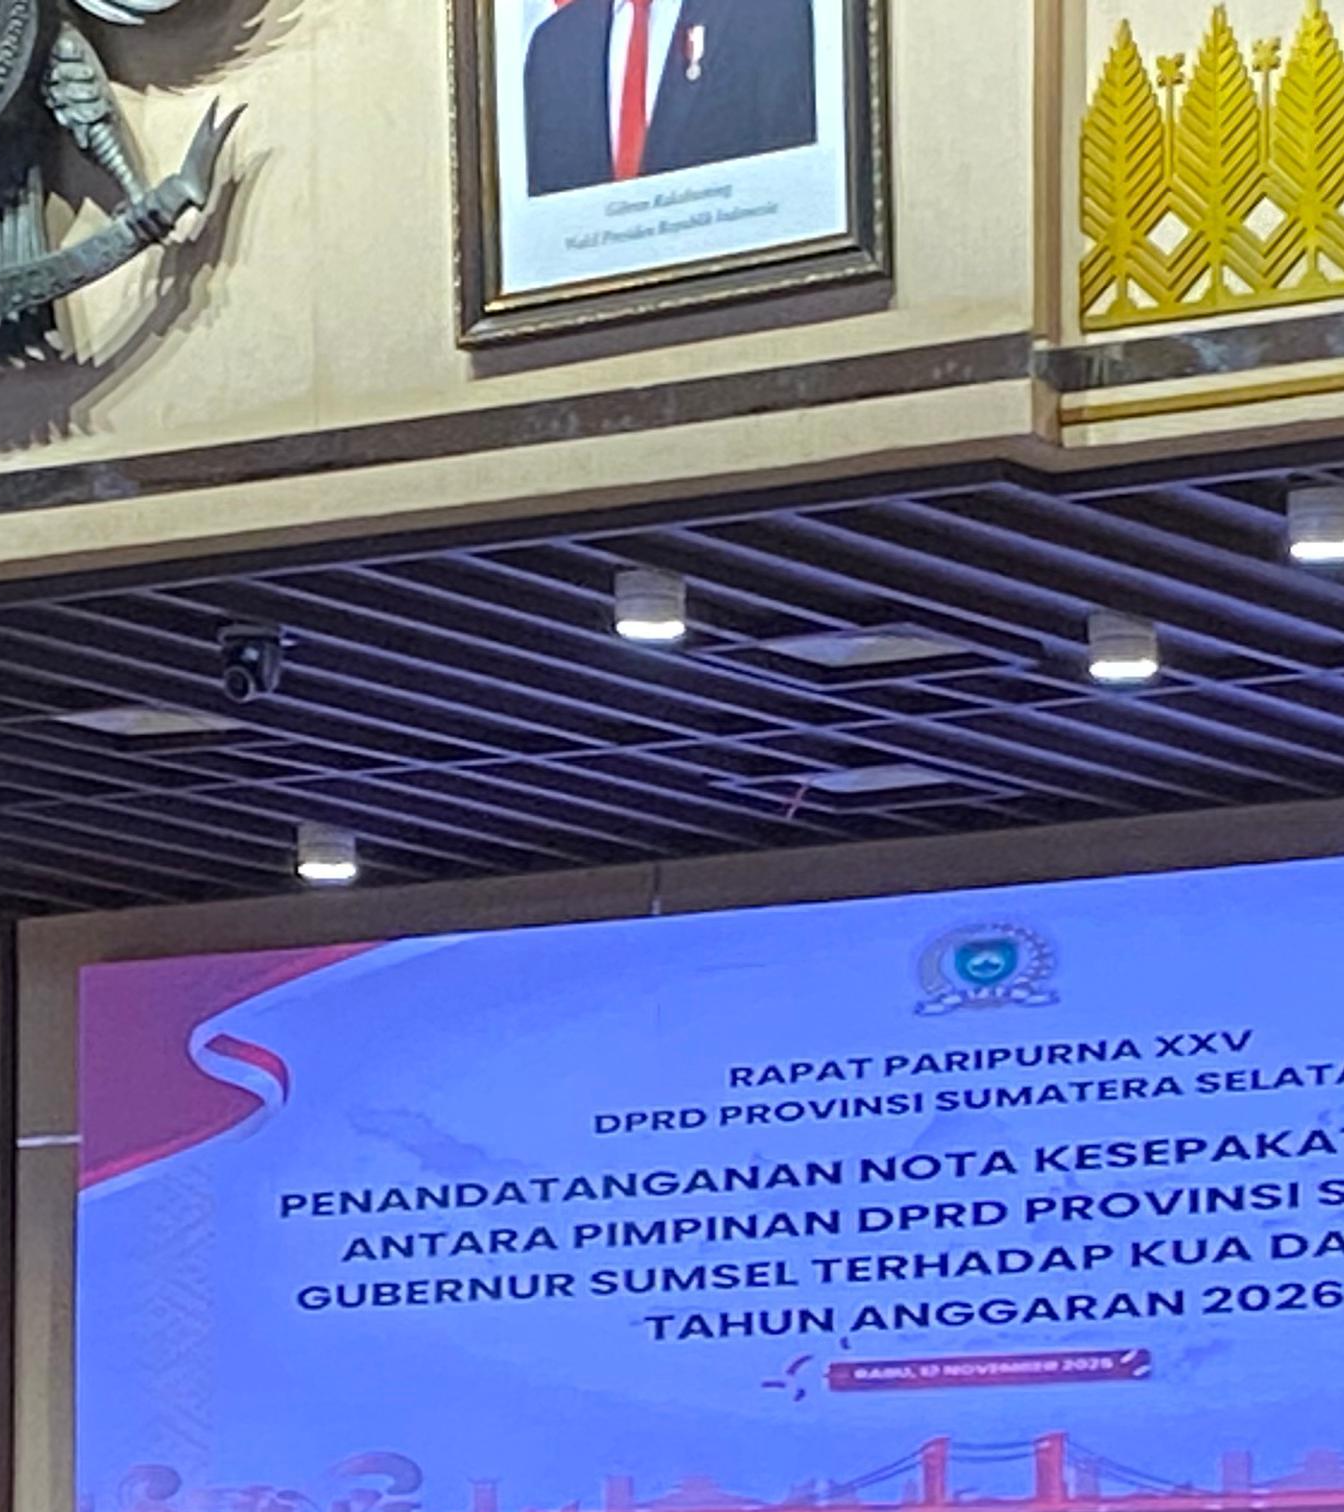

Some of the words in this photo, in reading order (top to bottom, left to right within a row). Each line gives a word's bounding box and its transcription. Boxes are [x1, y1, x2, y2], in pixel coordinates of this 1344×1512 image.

[729, 1057, 873, 1088] RAPAT
[884, 1038, 1142, 1077] PARIPURNA
[1156, 1030, 1252, 1058] XXV
[593, 1106, 710, 1136] DPRD
[717, 1093, 924, 1130] PROVINSI
[935, 1075, 1182, 1112] SUMATERA
[280, 1161, 843, 1219] PENANDATANGANAN
[860, 1149, 1018, 1184] NOTA
[342, 1225, 559, 1263] ANTARA
[574, 1209, 841, 1249] PIMPINAN
[858, 1200, 1008, 1233] DPRD
[1025, 1181, 1300, 1224] PROVINSI
[297, 1272, 575, 1311] GUBERNUR
[591, 1261, 798, 1296] SUMSEL
[811, 1244, 1114, 1283] TERHADAP
[1131, 1236, 1252, 1268] KUA
[644, 1307, 834, 1341] TAHUN
[850, 1289, 1185, 1332] ANGGARAN
[1203, 1280, 1344, 1314] 2026
